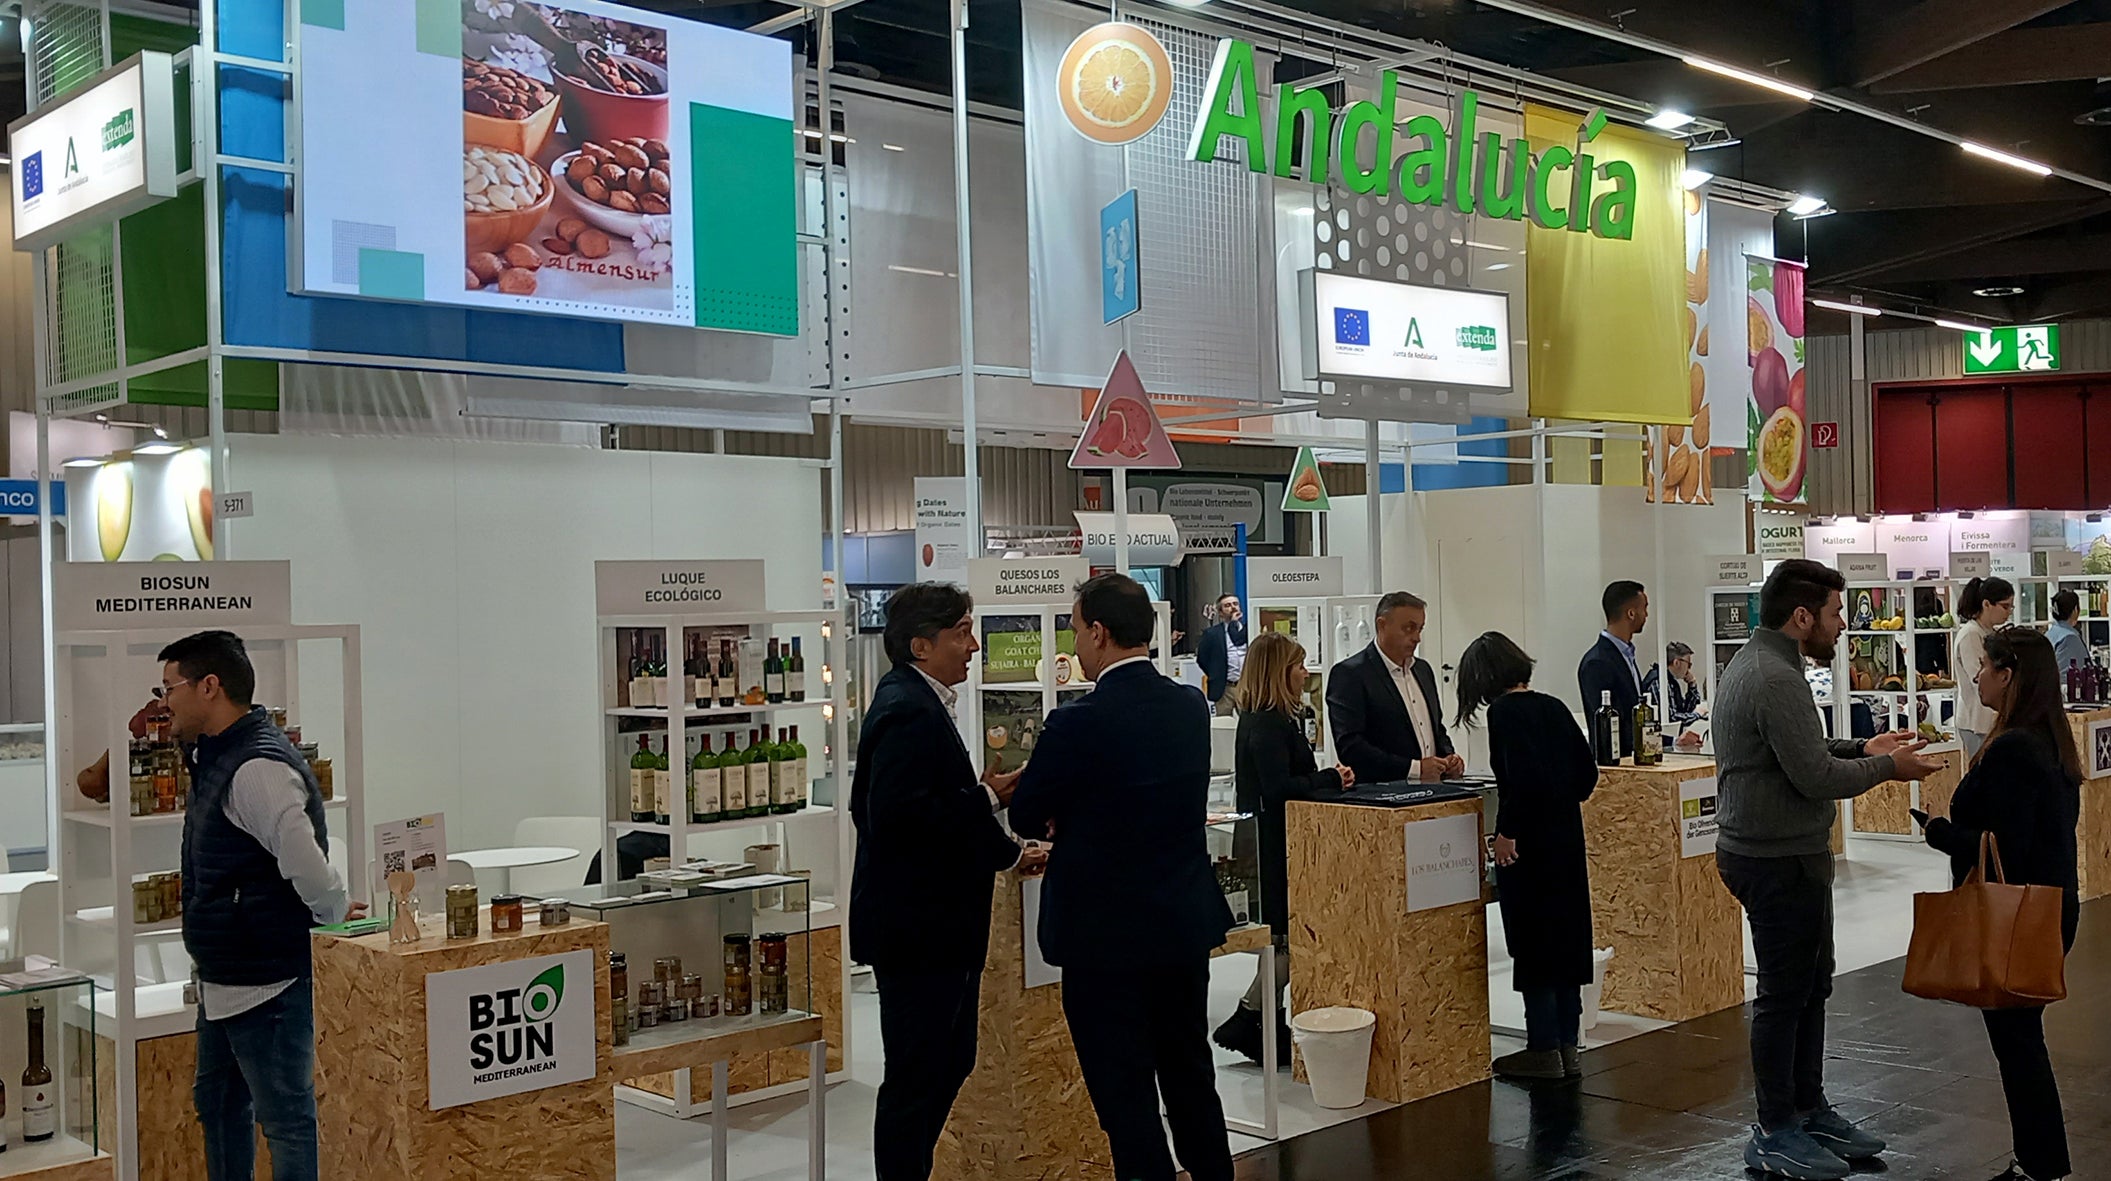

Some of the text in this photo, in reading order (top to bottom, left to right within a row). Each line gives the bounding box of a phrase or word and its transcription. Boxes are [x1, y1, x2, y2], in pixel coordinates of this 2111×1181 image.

[1185, 38, 1637, 240] Andalucía
[546, 256, 660, 281] Almensur
[1087, 534, 1107, 545] BIO
[1133, 534, 1174, 545] ACTUAL
[1822, 537, 1856, 545] Mallorca
[1894, 534, 1928, 542] Menorca
[1961, 532, 1990, 540] Eivissa
[661, 573, 705, 586] LUQUE
[1000, 569, 1060, 581] QUESOS LOS
[1271, 573, 1320, 582] OLEOESTEPA
[141, 576, 209, 590] BIOSUN
[995, 584, 1065, 595] BALANCHARES
[645, 587, 721, 602] ECOLÓGICO
[96, 597, 252, 612] MEDITERRANEAN
[470, 968, 564, 1031] BIO
[470, 1022, 554, 1070] SUN
[473, 1060, 557, 1085] MEDITERRANEAN
